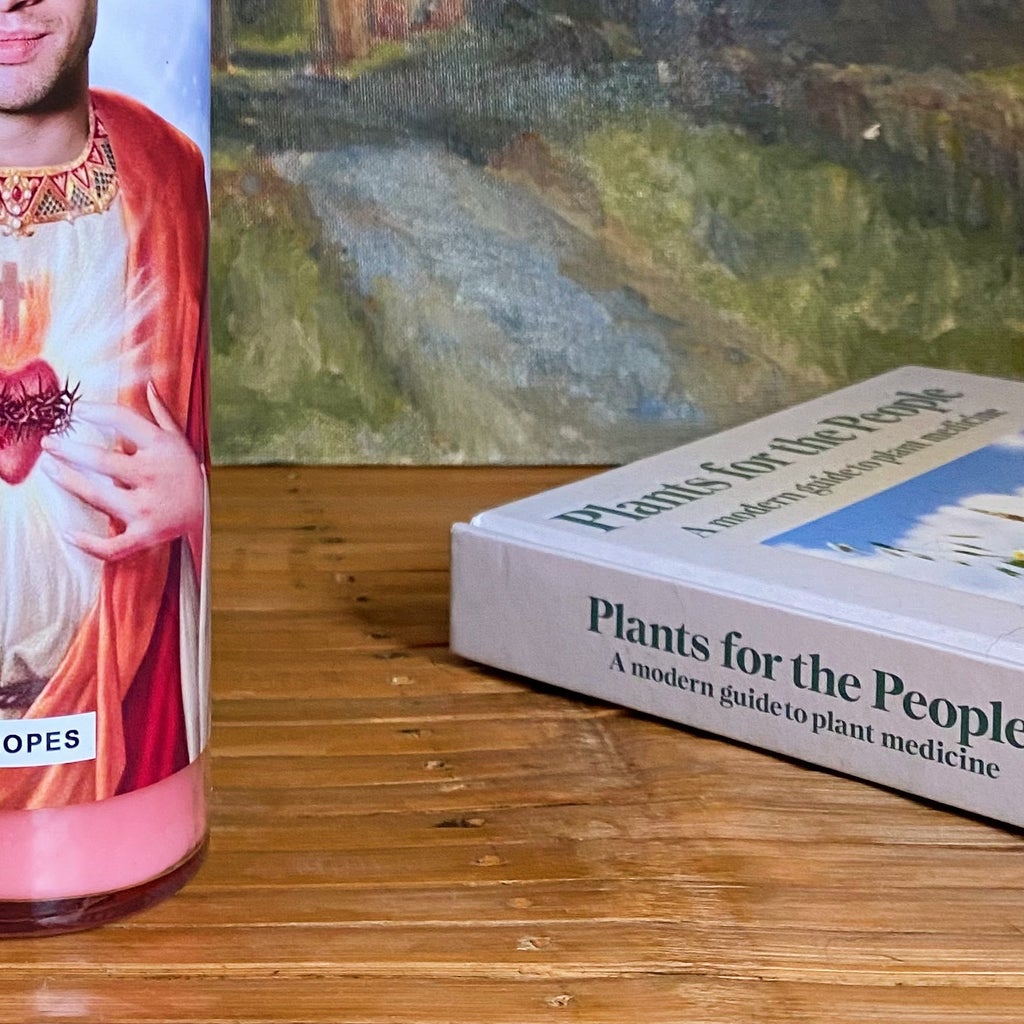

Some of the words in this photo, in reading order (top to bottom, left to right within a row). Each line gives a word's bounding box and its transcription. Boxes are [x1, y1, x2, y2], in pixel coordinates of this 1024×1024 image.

[549, 476, 732, 533] Plants
[700, 452, 795, 481] for
[769, 427, 857, 456] the
[818, 388, 964, 434] People
[681, 525, 718, 539] A
[708, 491, 806, 529] modern
[795, 469, 862, 497] guide
[587, 595, 711, 662] Plants
[720, 630, 783, 682] for
[790, 652, 862, 703] the
[871, 667, 1024, 749] People
[609, 651, 626, 673] A
[631, 660, 714, 698] modern
[719, 684, 782, 717] guide
[784, 700, 808, 724] to
[812, 710, 875, 744] plant
[881, 731, 1001, 780] medicine
